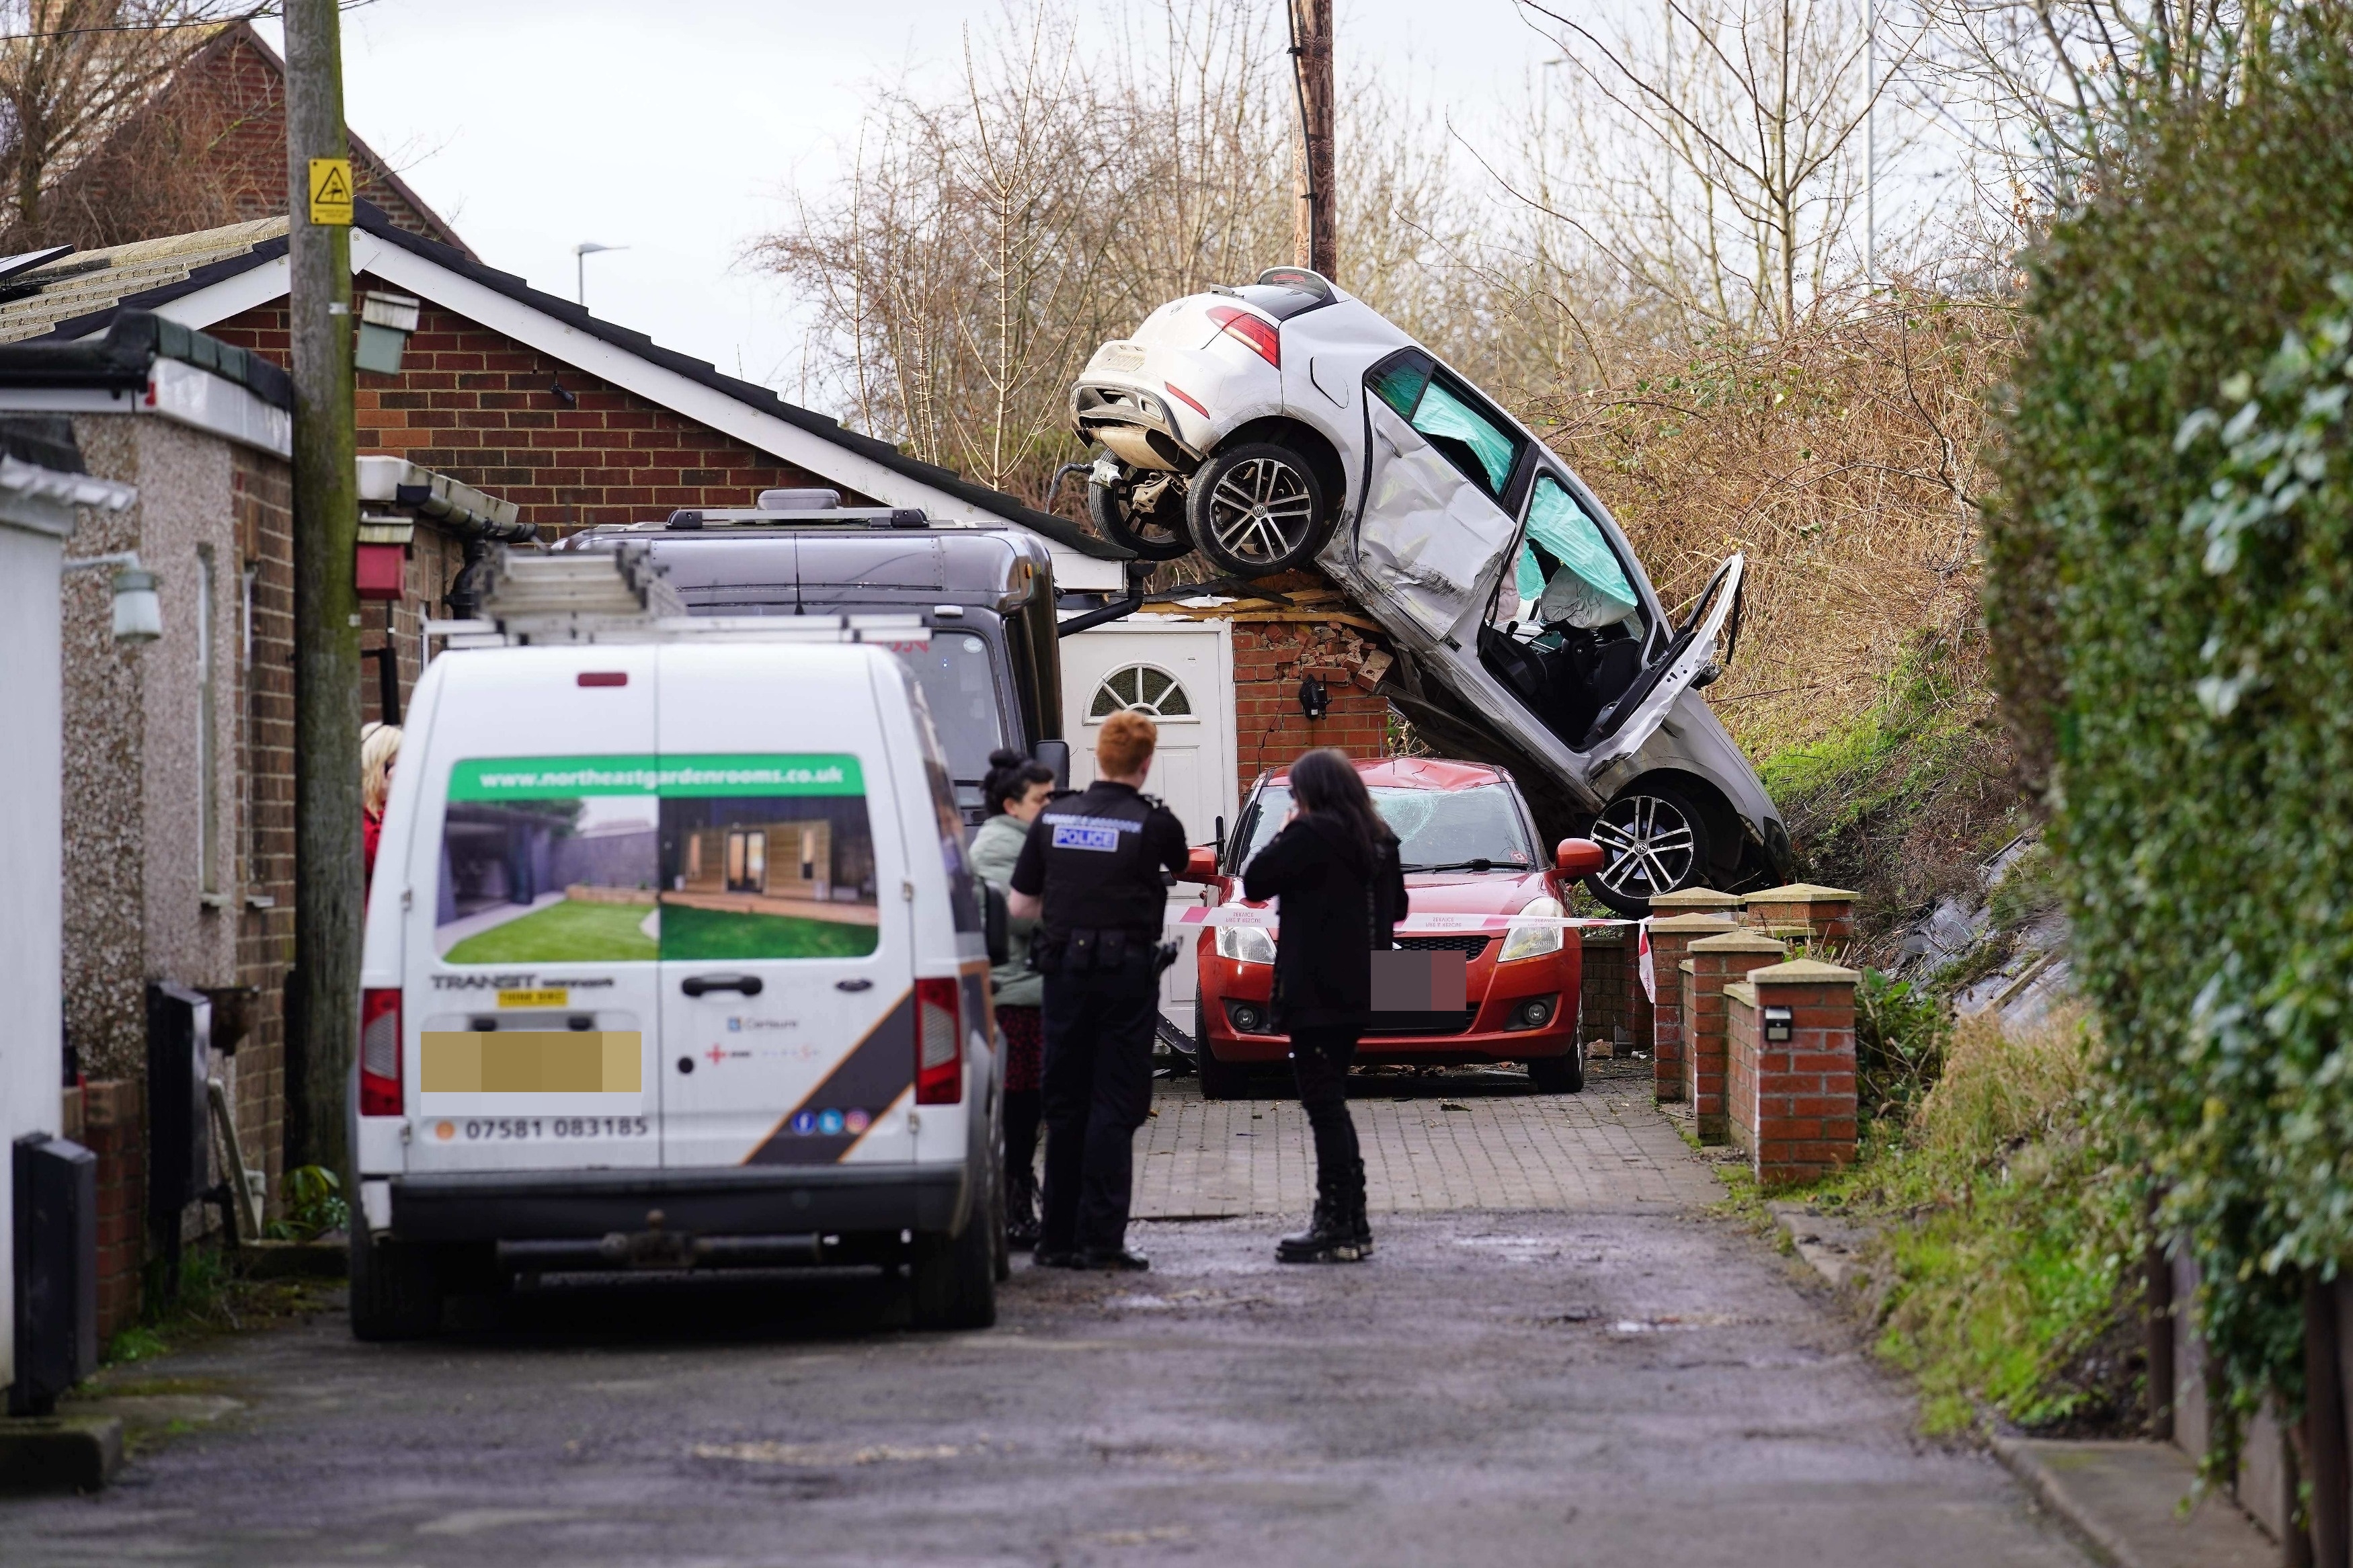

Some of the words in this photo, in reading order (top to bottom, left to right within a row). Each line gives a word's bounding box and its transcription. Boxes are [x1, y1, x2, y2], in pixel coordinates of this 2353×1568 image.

[479, 766, 843, 790] www.northeastgardenrooms.co.uk
[1055, 827, 1115, 849] POLICE
[432, 974, 536, 989] TRANSIT
[466, 1120, 543, 1139] 07581
[554, 1117, 649, 1137] 083185
